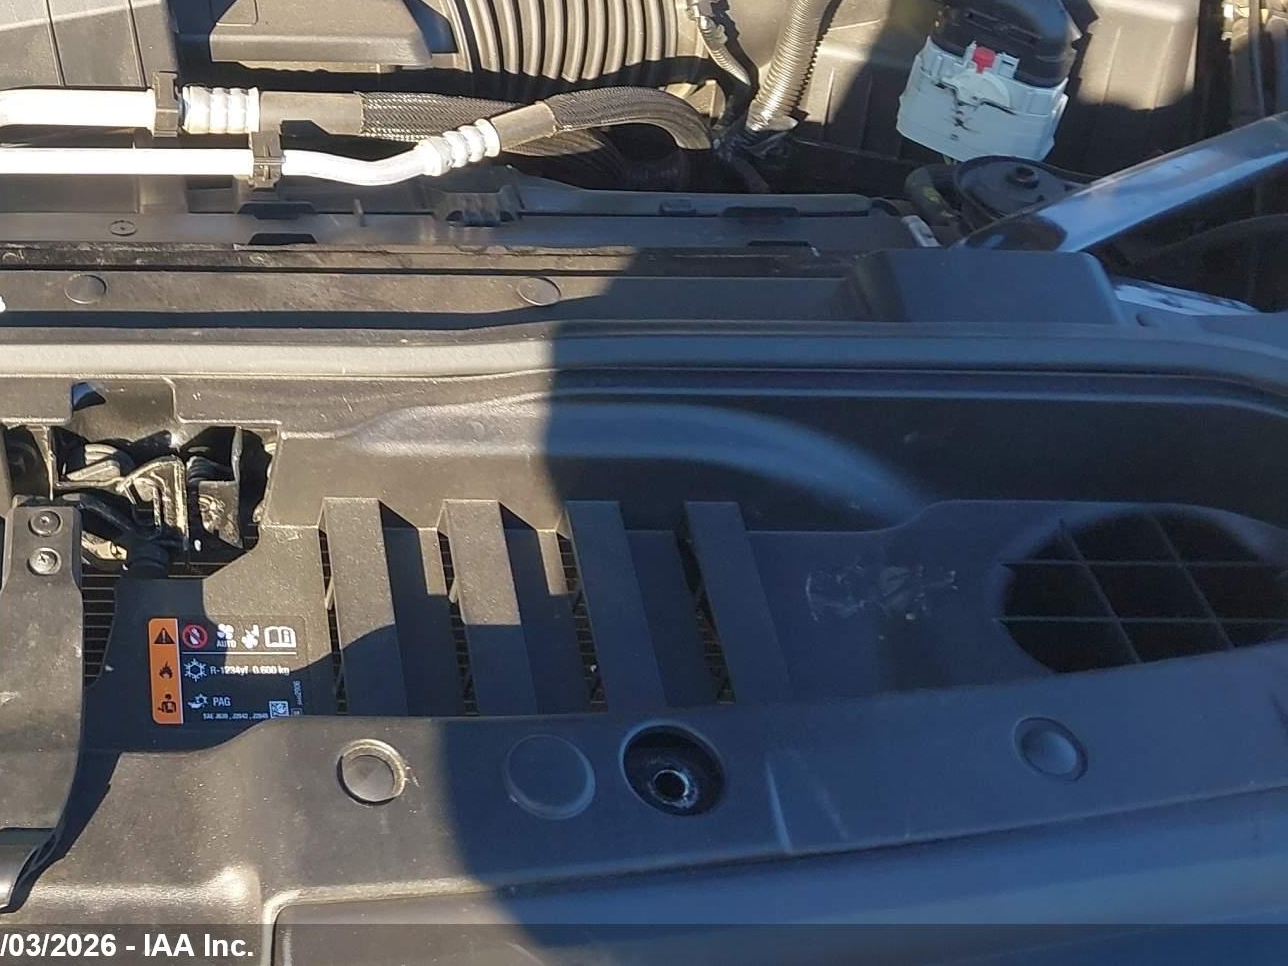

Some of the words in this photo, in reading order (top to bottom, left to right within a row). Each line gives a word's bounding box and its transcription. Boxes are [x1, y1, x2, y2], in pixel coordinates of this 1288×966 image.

[216, 639, 237, 648] AUTO
[278, 665, 290, 675] kg
[212, 696, 231, 707] PAG
